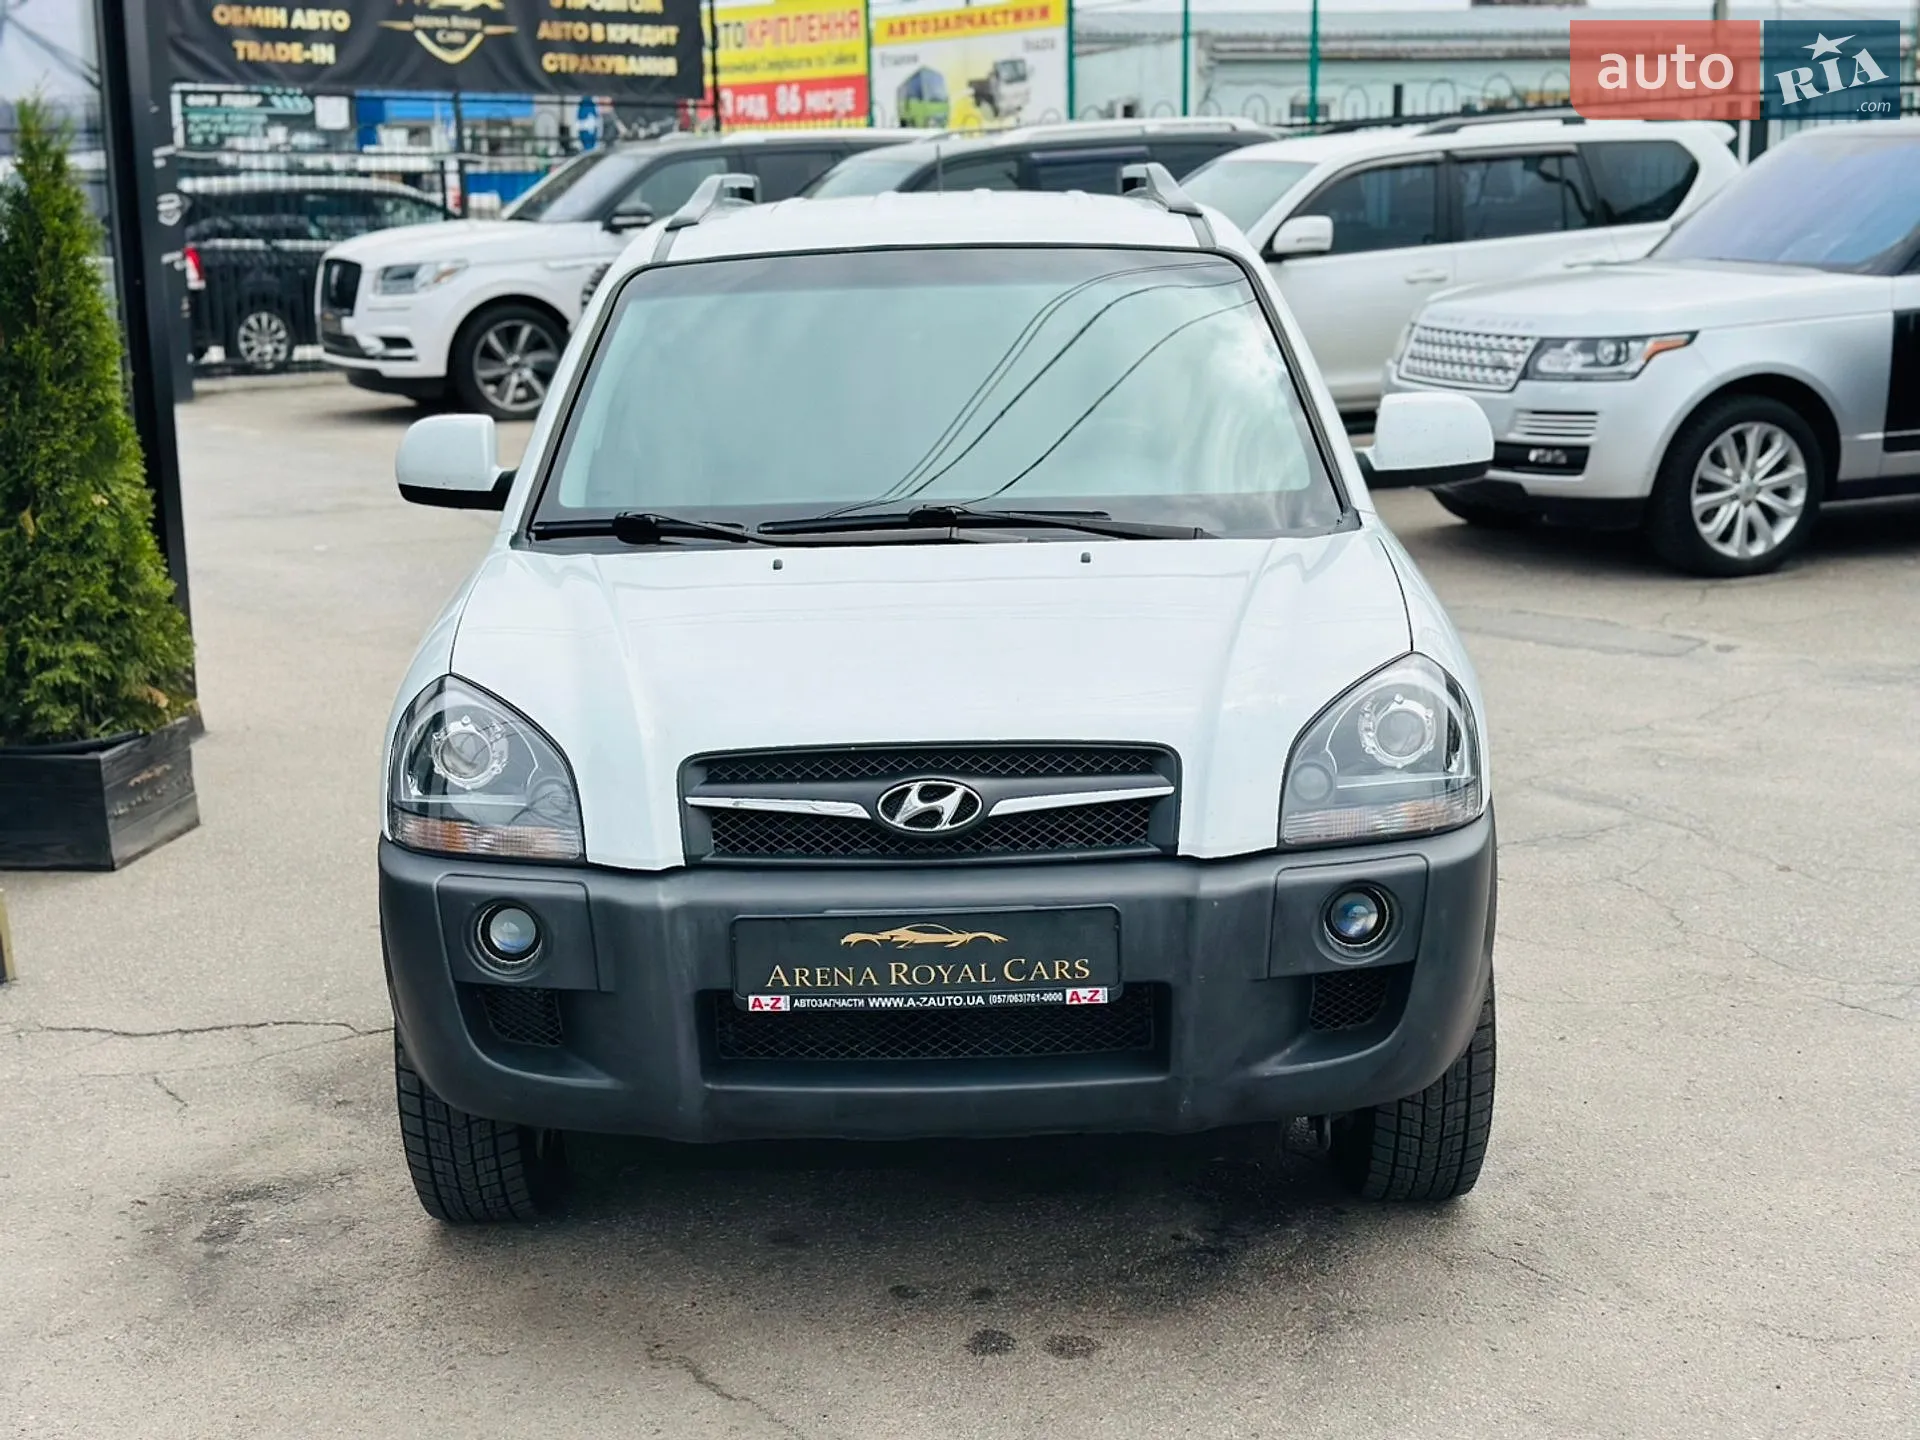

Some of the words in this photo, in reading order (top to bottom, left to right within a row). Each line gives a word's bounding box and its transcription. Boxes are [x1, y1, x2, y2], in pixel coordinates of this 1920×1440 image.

[212, 4, 288, 29] ОБМІН
[290, 8, 351, 32] АВТО
[705, 9, 861, 51] ТОКРІПЛЕННЯ
[886, 5, 1051, 38] АВТОЗАПЧАСТИНИ
[537, 20, 590, 42] АВТО
[590, 22, 606, 43] В
[606, 23, 679, 47] КРЕДИТ
[231, 40, 336, 64] TRADE-IN
[541, 51, 678, 76] СТРАХУВАННЯ
[765, 964, 880, 988] ARENA
[888, 961, 996, 987] ROYAL
[1003, 957, 1091, 983] CARS
[751, 997, 782, 1010] A-Z
[793, 998, 865, 1009] АВТОЗАПЧАСТИ
[868, 995, 986, 1009] WWW.A-ZAUTO.UA
[1068, 989, 1101, 1004] A-Z
